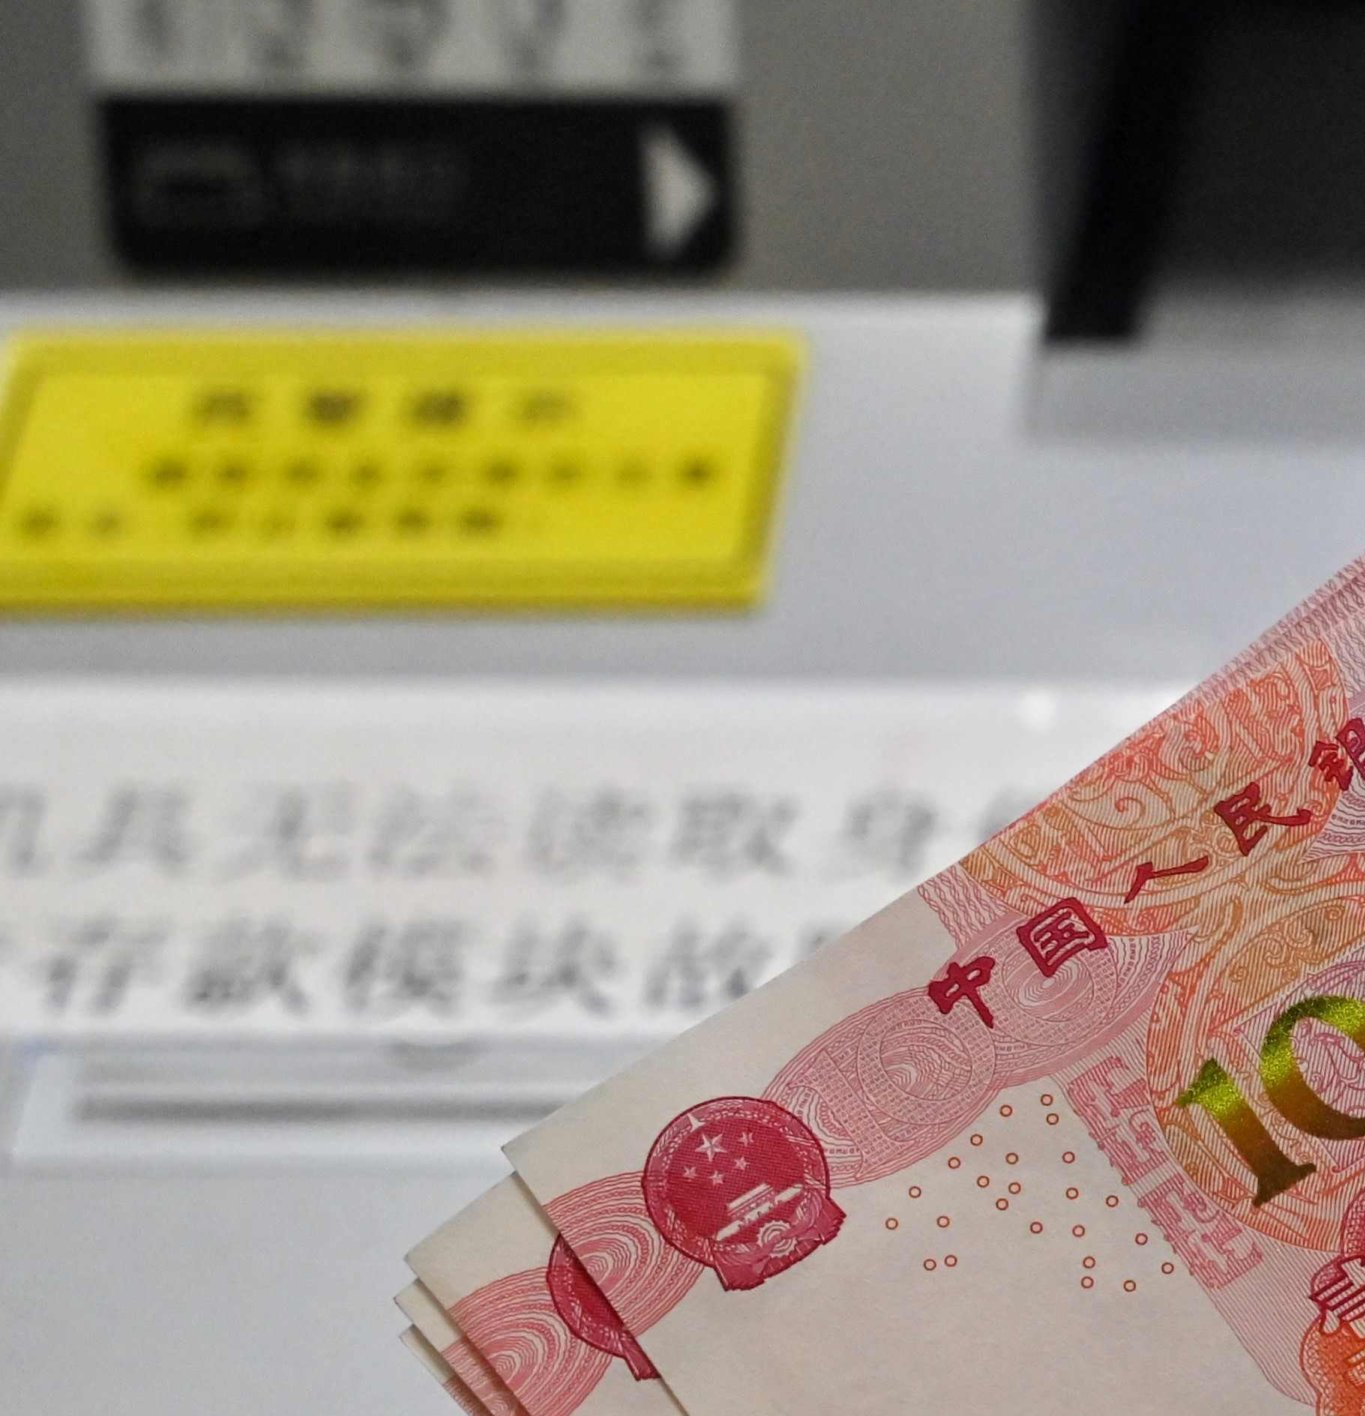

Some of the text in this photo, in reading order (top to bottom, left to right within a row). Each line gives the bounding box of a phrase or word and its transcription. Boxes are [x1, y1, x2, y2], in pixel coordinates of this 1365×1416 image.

[0, 782, 1045, 884] 具无法读取身
[45, 910, 850, 1018] 存款模块故
